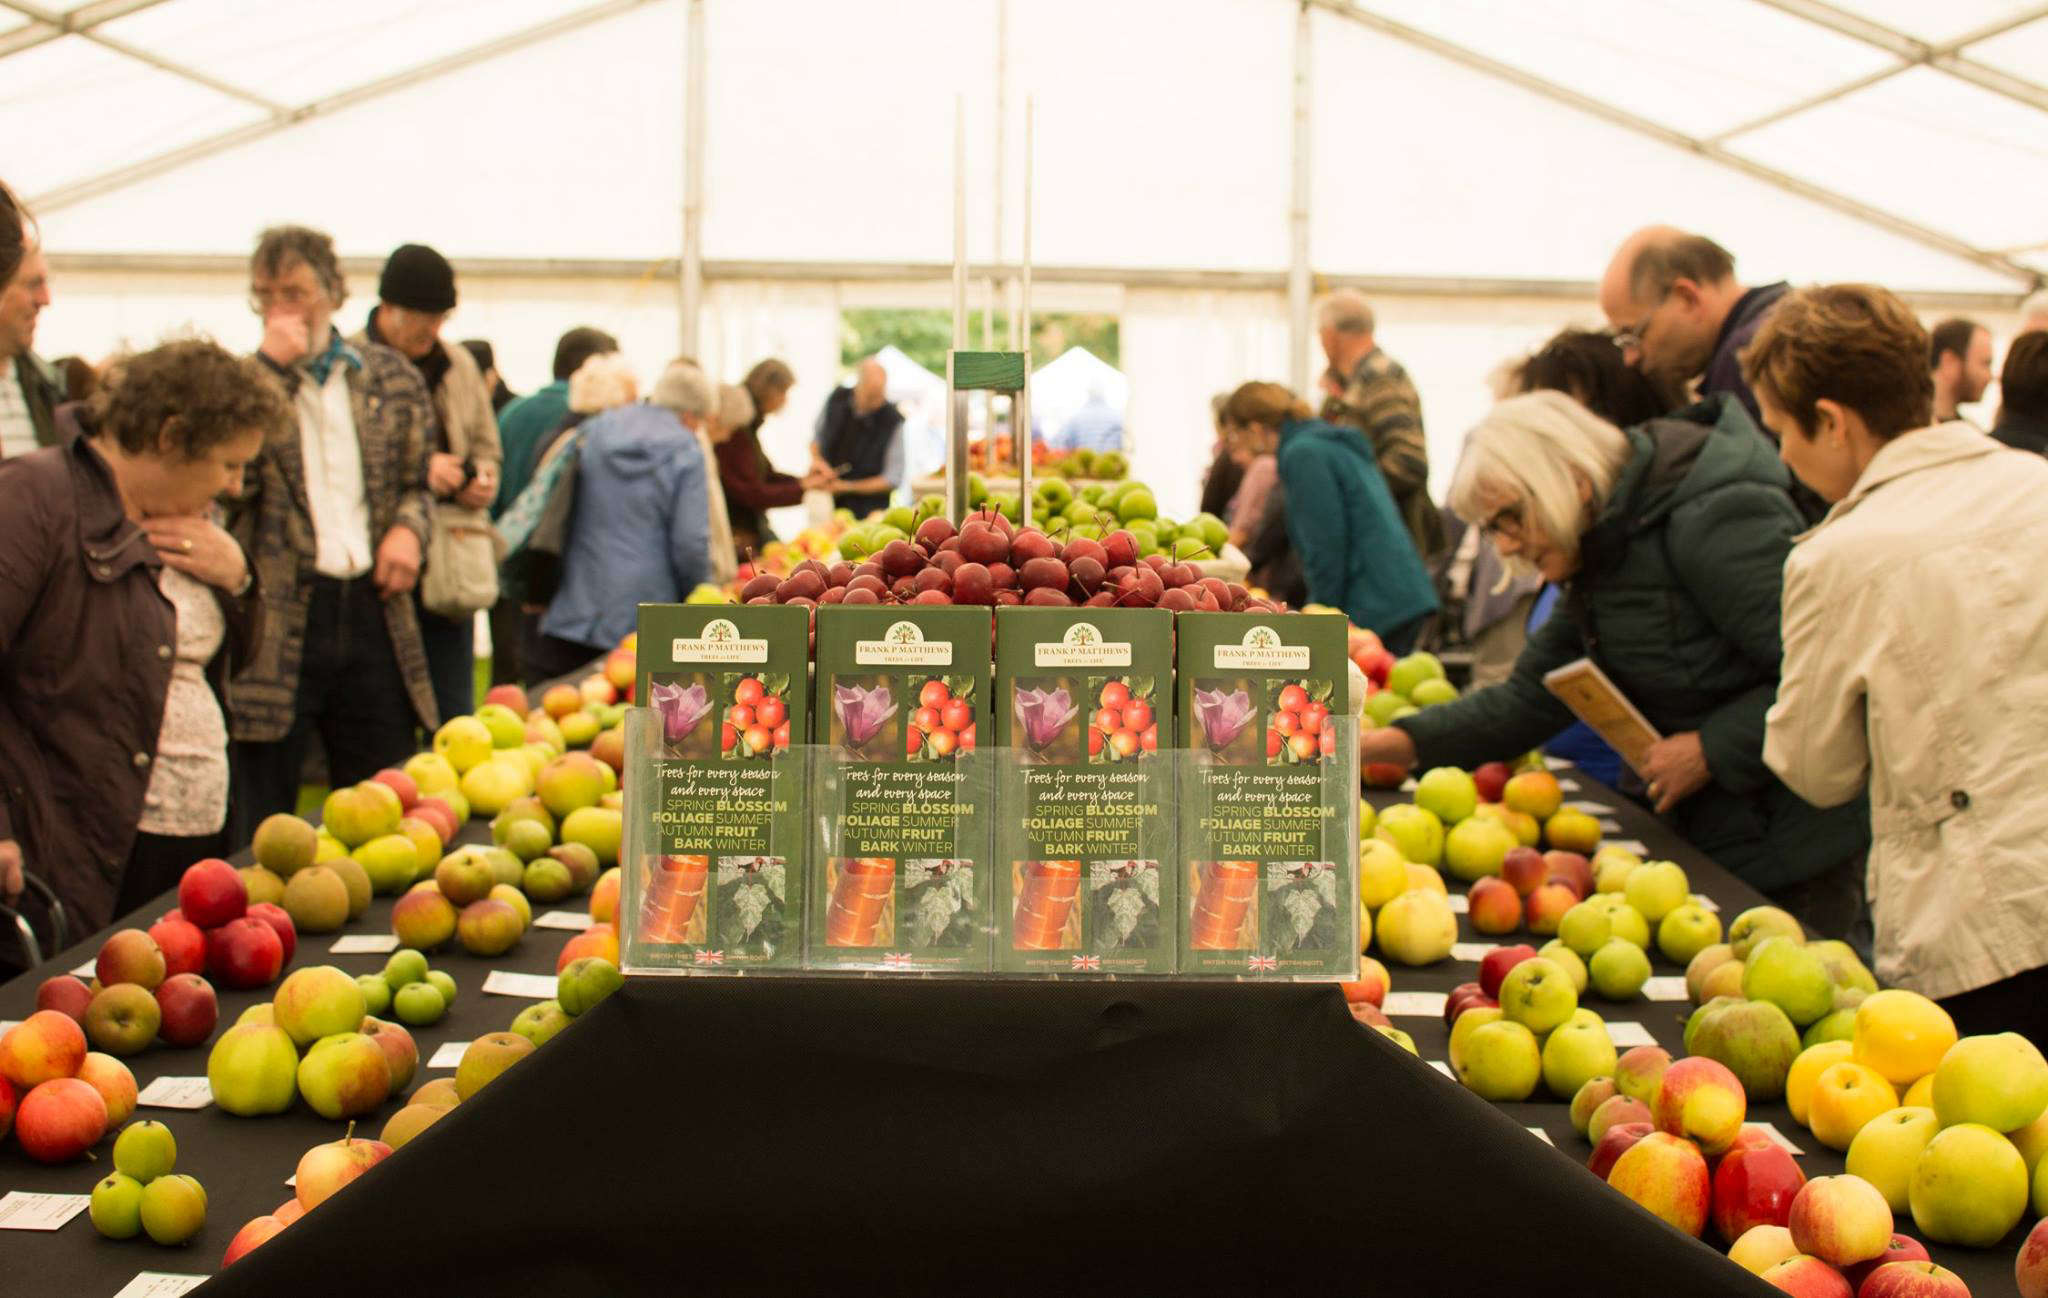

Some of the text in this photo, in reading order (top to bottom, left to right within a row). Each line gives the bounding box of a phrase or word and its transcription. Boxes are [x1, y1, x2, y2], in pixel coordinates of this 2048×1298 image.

[1038, 647, 1068, 655] FRANK
[1078, 647, 1128, 655] MATTHEWS
[653, 764, 684, 779] Trees
[686, 765, 704, 782] for
[708, 768, 739, 785] every
[838, 766, 967, 788] Trees for every season
[1020, 769, 1150, 789] Trees for every season
[1199, 770, 1230, 784] Trees
[1232, 770, 1250, 789] for
[1253, 774, 1286, 791] every
[671, 781, 765, 802] and every space
[856, 784, 952, 804] and every space
[1039, 786, 1134, 806] and every space
[1217, 788, 1312, 808] and every space
[667, 800, 787, 811] SPRING BLOSSOM
[852, 802, 974, 814] SPRING BLOSSOM
[1036, 805, 1157, 816] SPRING BLOSSOM
[652, 812, 773, 824] FOLIAGE SUMMER
[1214, 806, 1335, 818] SPRING BLOSSOM
[838, 815, 959, 827] FOLIAGE SUMMER
[1022, 818, 1143, 828] FOLIAGE SUMMER
[1200, 819, 1321, 830] FOLIAGE SUMMER
[656, 825, 758, 837] AUTUMN FRUIT
[844, 828, 945, 840] AUTUMN FRUIT
[1028, 830, 1129, 841] AUTUMN FRUIT
[1205, 832, 1306, 842] AUTUMN FRUIT
[674, 838, 766, 850] BARK WINTER
[861, 841, 952, 852] BARK WINTER
[1046, 843, 1138, 854] BARK WINTER
[1223, 844, 1314, 856] BARK WINTER
